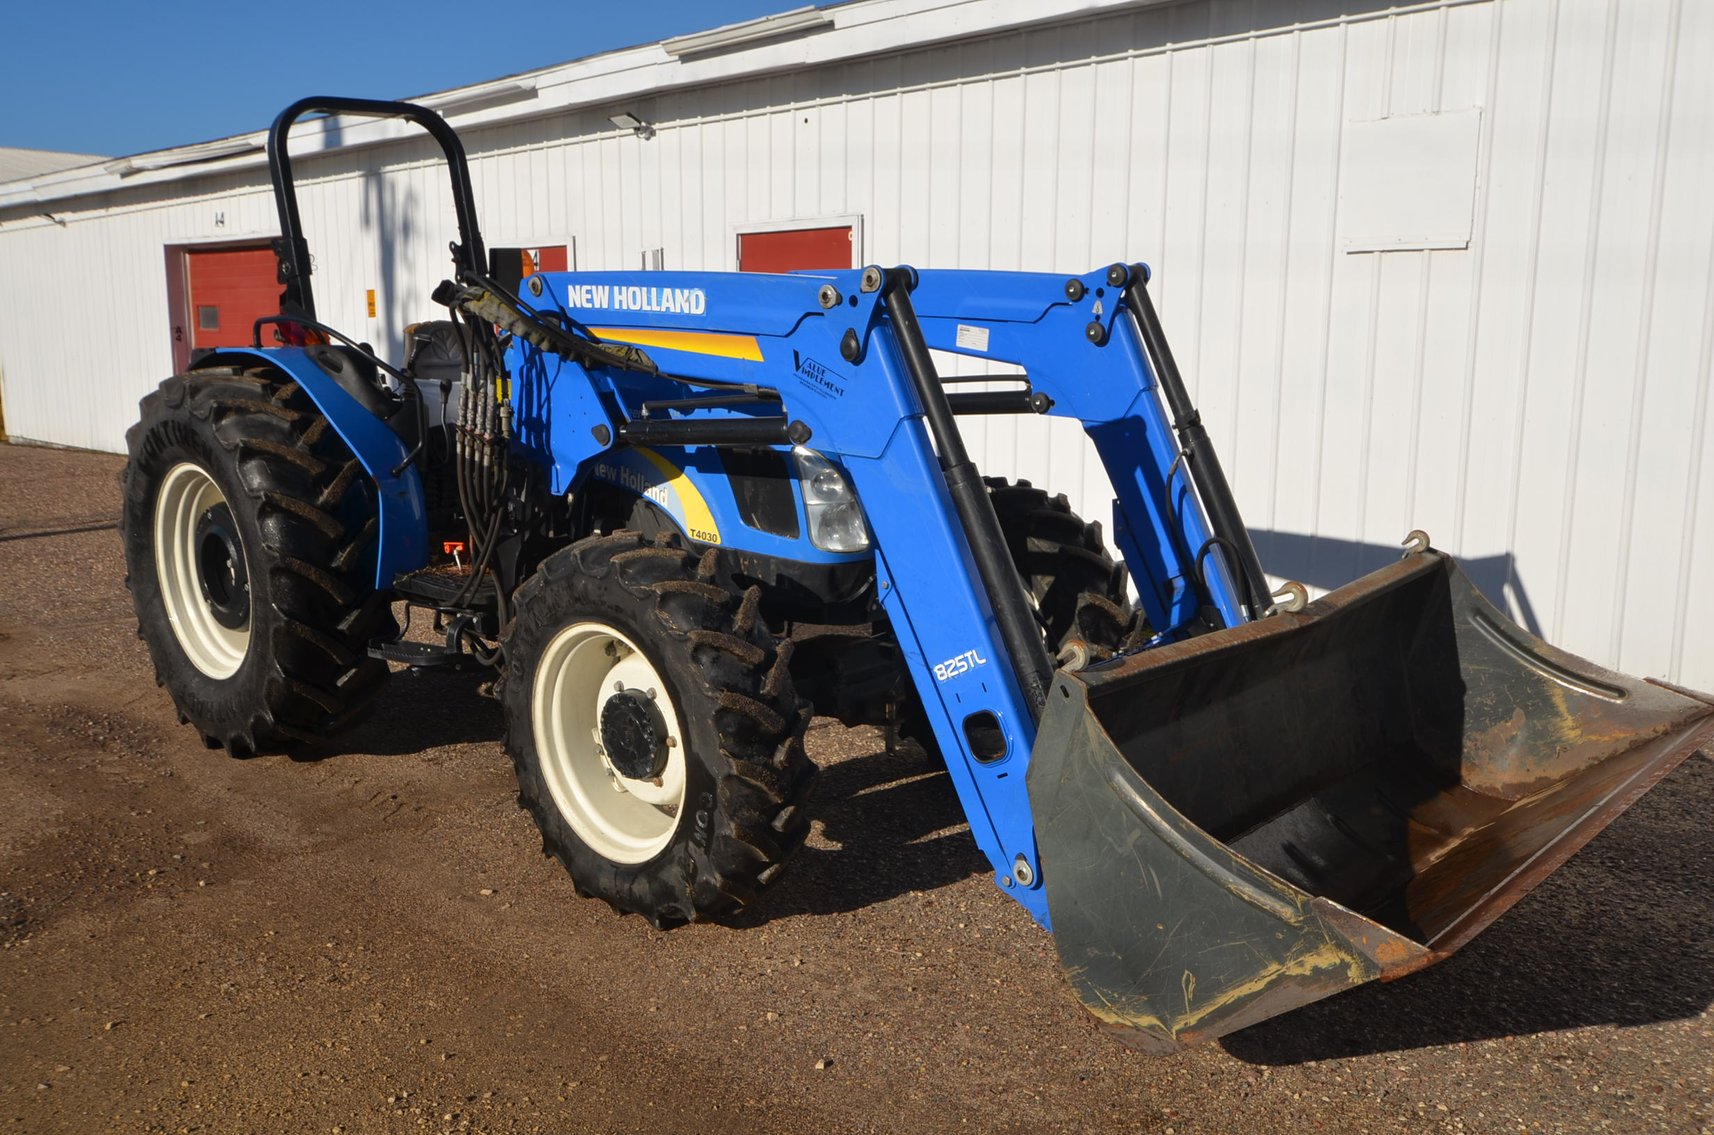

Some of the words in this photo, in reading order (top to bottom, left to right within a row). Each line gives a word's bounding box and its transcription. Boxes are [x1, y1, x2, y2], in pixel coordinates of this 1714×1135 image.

[568, 285, 609, 309] NEW
[613, 285, 706, 315] HOLLAND
[801, 366, 844, 397] IMPLEMENT
[620, 465, 668, 507] Holland
[690, 528, 718, 543] T4030
[933, 649, 987, 681] 825TL
